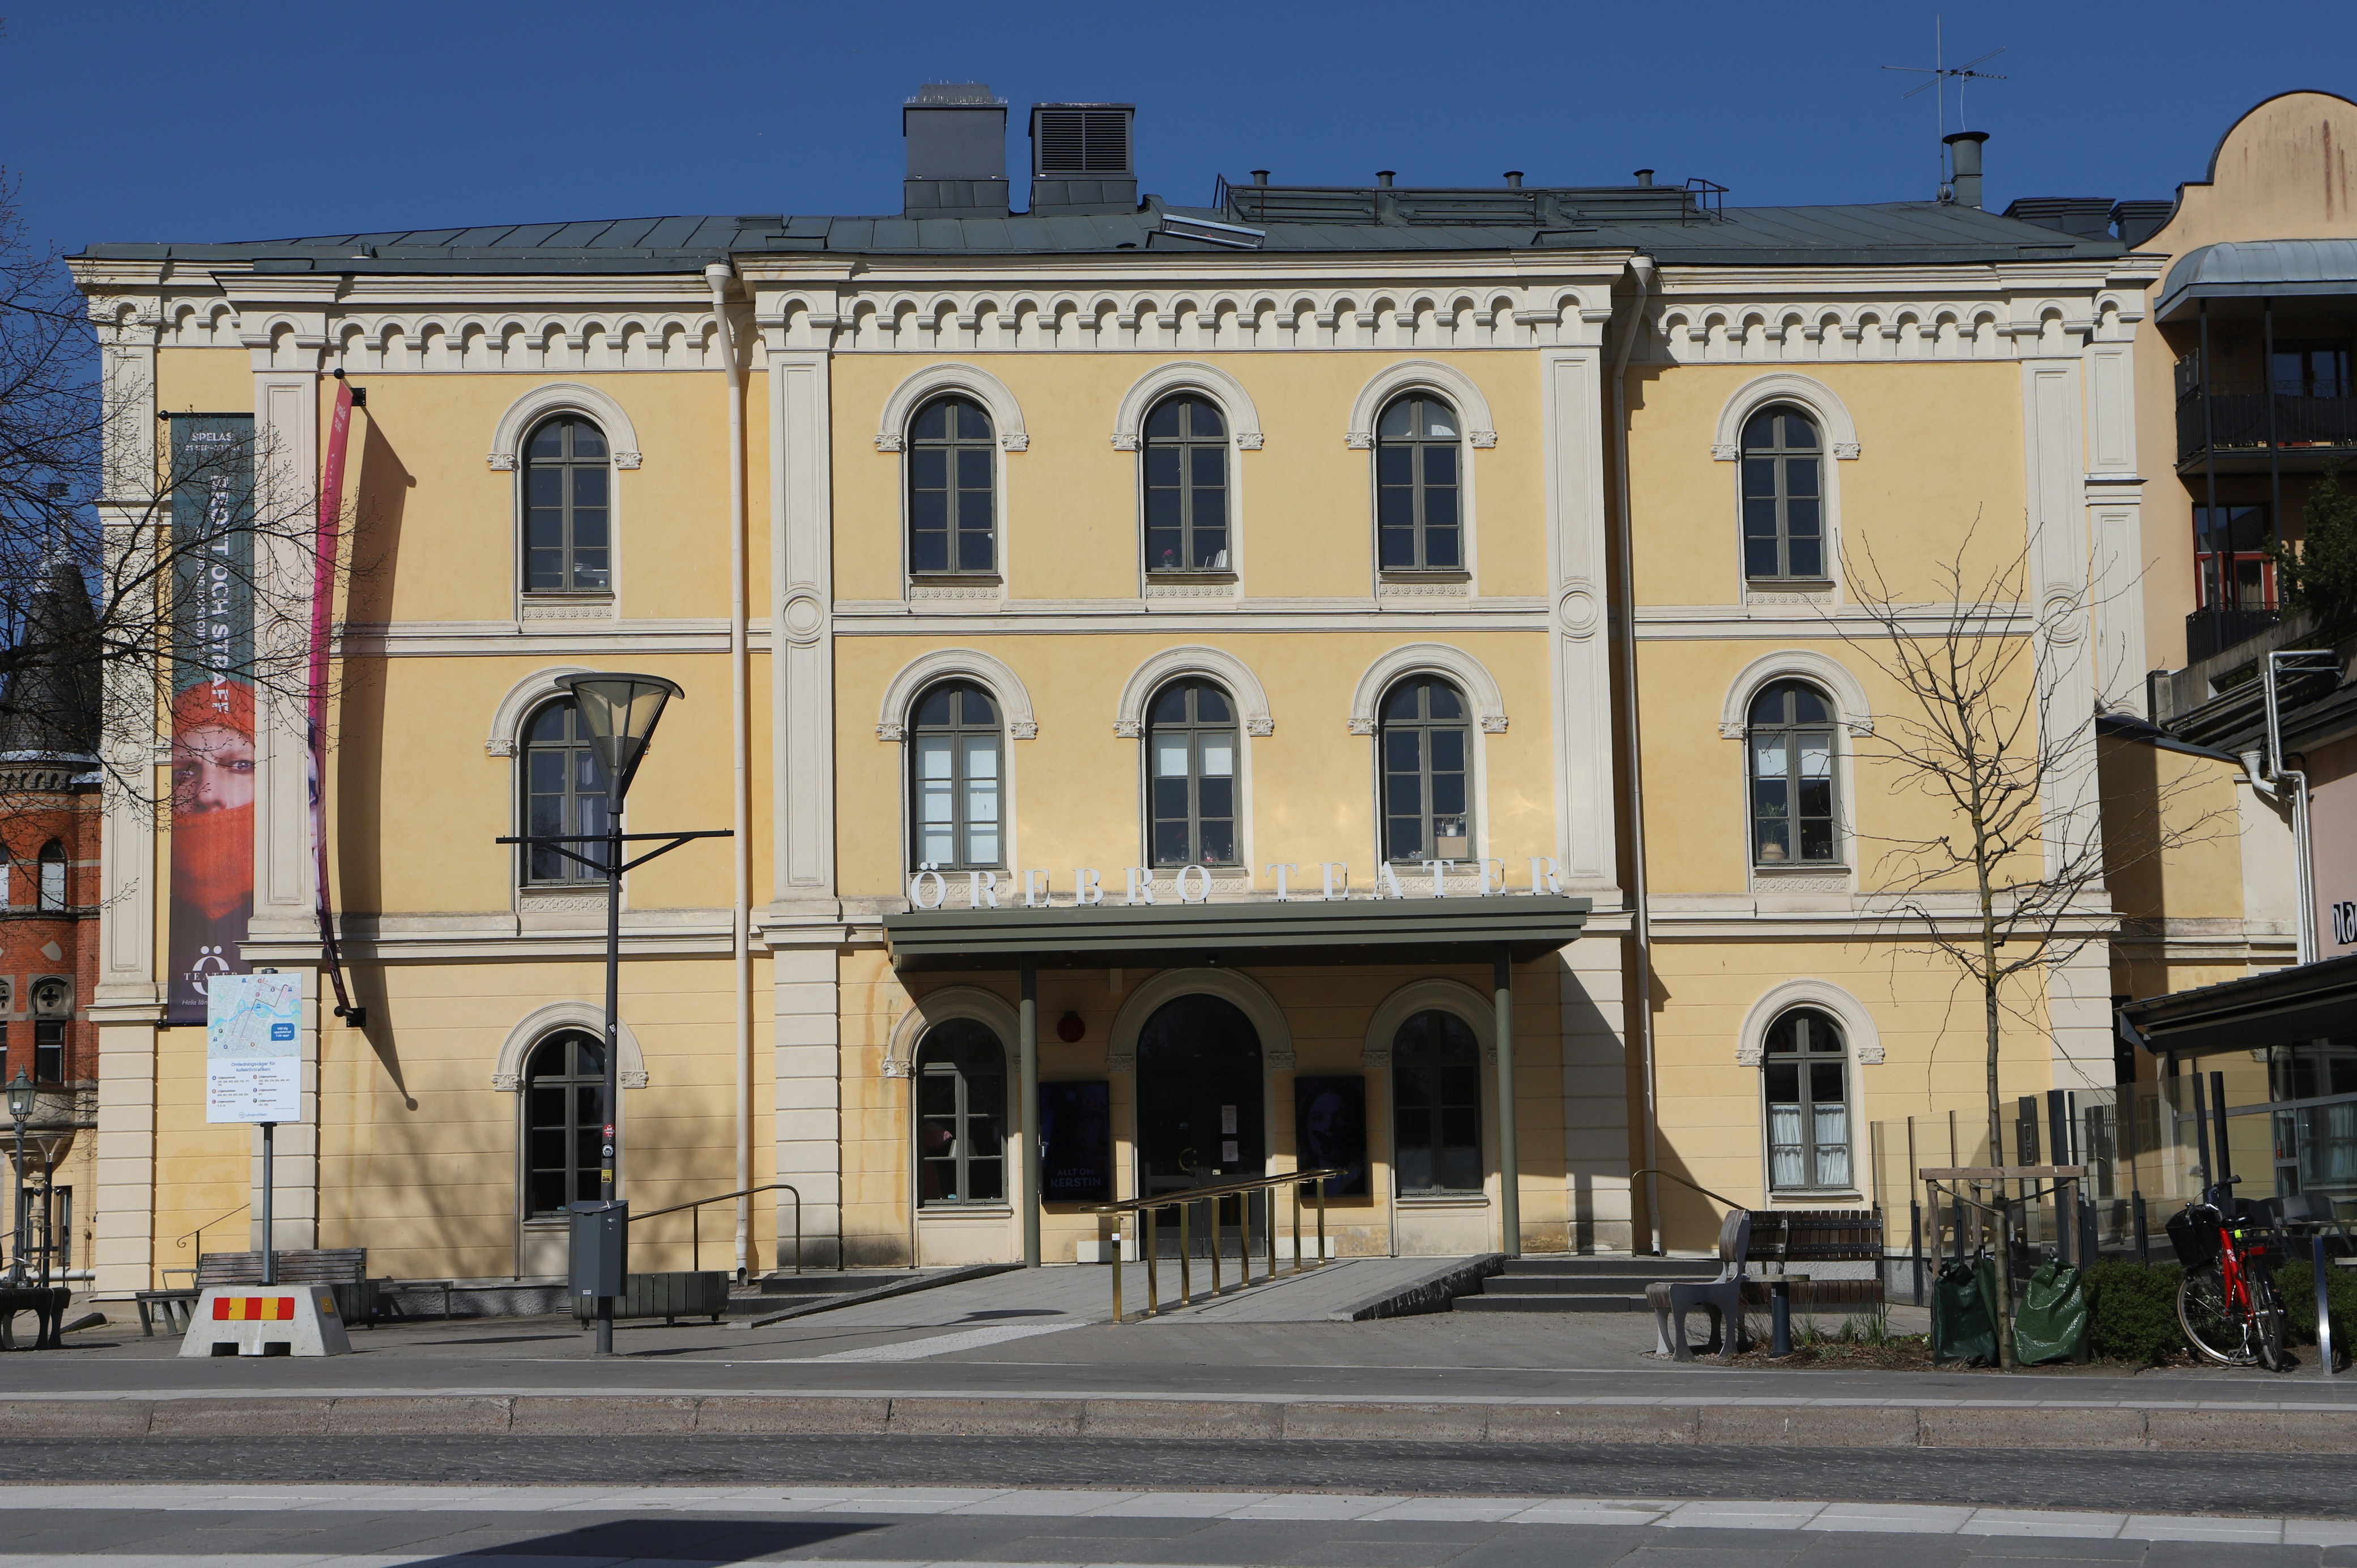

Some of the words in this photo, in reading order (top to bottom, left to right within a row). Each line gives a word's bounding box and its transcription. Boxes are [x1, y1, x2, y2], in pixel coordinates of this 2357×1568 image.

[192, 432, 233, 441] SPELAS
[211, 564, 229, 615] OCH
[211, 624, 229, 714] STRAFF
[911, 862, 1211, 909] ÖREBRO
[1266, 856, 1563, 901] TEATER
[1050, 1177, 1101, 1188] KERSTIN
